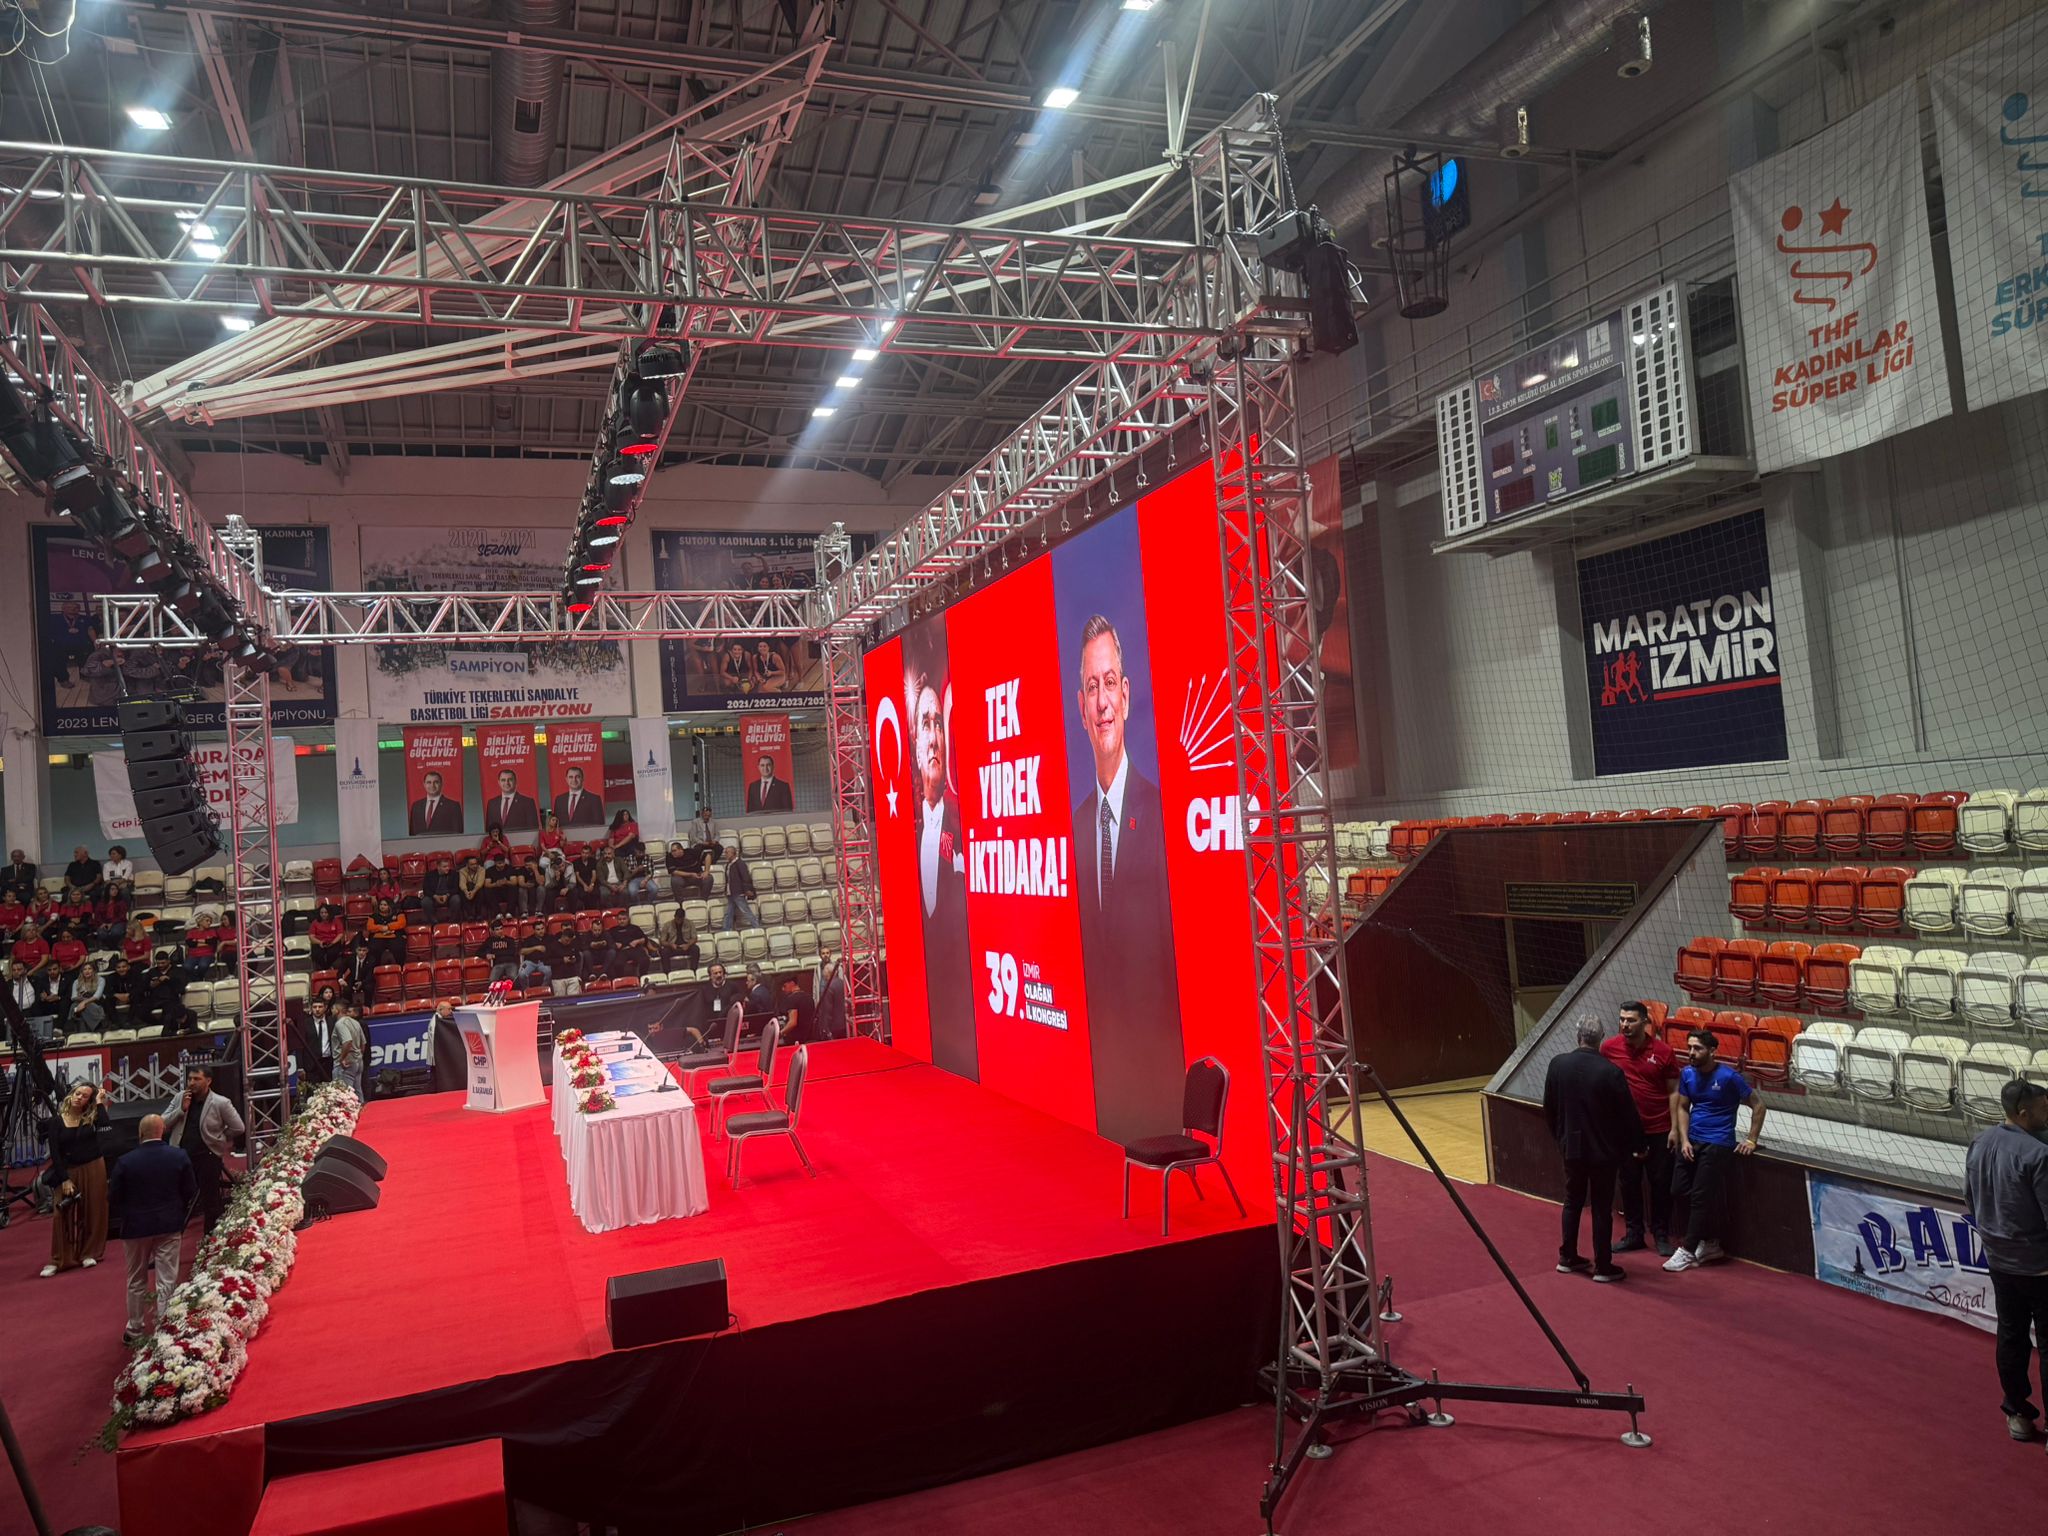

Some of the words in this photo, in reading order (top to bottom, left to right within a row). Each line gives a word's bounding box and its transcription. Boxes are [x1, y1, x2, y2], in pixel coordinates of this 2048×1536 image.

[1994, 263, 2048, 306] ERK
[1990, 296, 2048, 338] SÜP
[1808, 311, 1859, 348] THF
[1773, 320, 1908, 387] KADINLAR
[1771, 371, 1858, 413] SÜPER
[1866, 337, 1915, 385] LİGİ
[264, 529, 314, 538] KADINLAR
[500, 529, 537, 549] 2021
[679, 535, 717, 546] SUTOPU
[719, 536, 767, 547] KADINLAR
[780, 534, 794, 547] LİG
[477, 543, 522, 557] SEZONU
[1593, 586, 1773, 656] MARATON
[450, 657, 525, 673] ŞAMPİYON
[424, 688, 466, 704] TÜRKİYE
[470, 686, 525, 703] TEKERLEKLİ
[527, 687, 579, 701] SANDALYE
[410, 706, 467, 721] BASKETBOL
[470, 704, 489, 719] LİGİ
[490, 700, 593, 719] ŞAMPİYONU
[984, 677, 1021, 743] TEK
[56, 717, 89, 730] 2023
[92, 715, 119, 728] LEN
[747, 723, 782, 734] BİRLİKTE
[413, 735, 453, 748] BİRLİKTE
[486, 733, 526, 746] BİRLİKTE
[554, 731, 593, 744] BİRLİKTE
[409, 747, 458, 760] GÜÇLÜYÜZ!
[483, 744, 530, 759] GÜÇLÜYÜZ!
[552, 742, 597, 756] GÜÇLÜYÜZ!
[978, 751, 1042, 819] YÜREK
[112, 820, 132, 830] CHP
[1186, 793, 1261, 853] CHP
[968, 826, 1068, 898] İKTİDARA!
[492, 941, 508, 949] ICON
[1022, 959, 1041, 979] İZMİR
[1023, 982, 1053, 1004] OLAĞAN
[1032, 1006, 1068, 1030] KONGRESİ
[473, 1055, 487, 1067] CHP
[1858, 1206, 1991, 1276] BAD
[1924, 1284, 1987, 1315] Doğal
[1358, 1398, 1388, 1413] VISION
[1575, 1397, 1600, 1406] VISION
